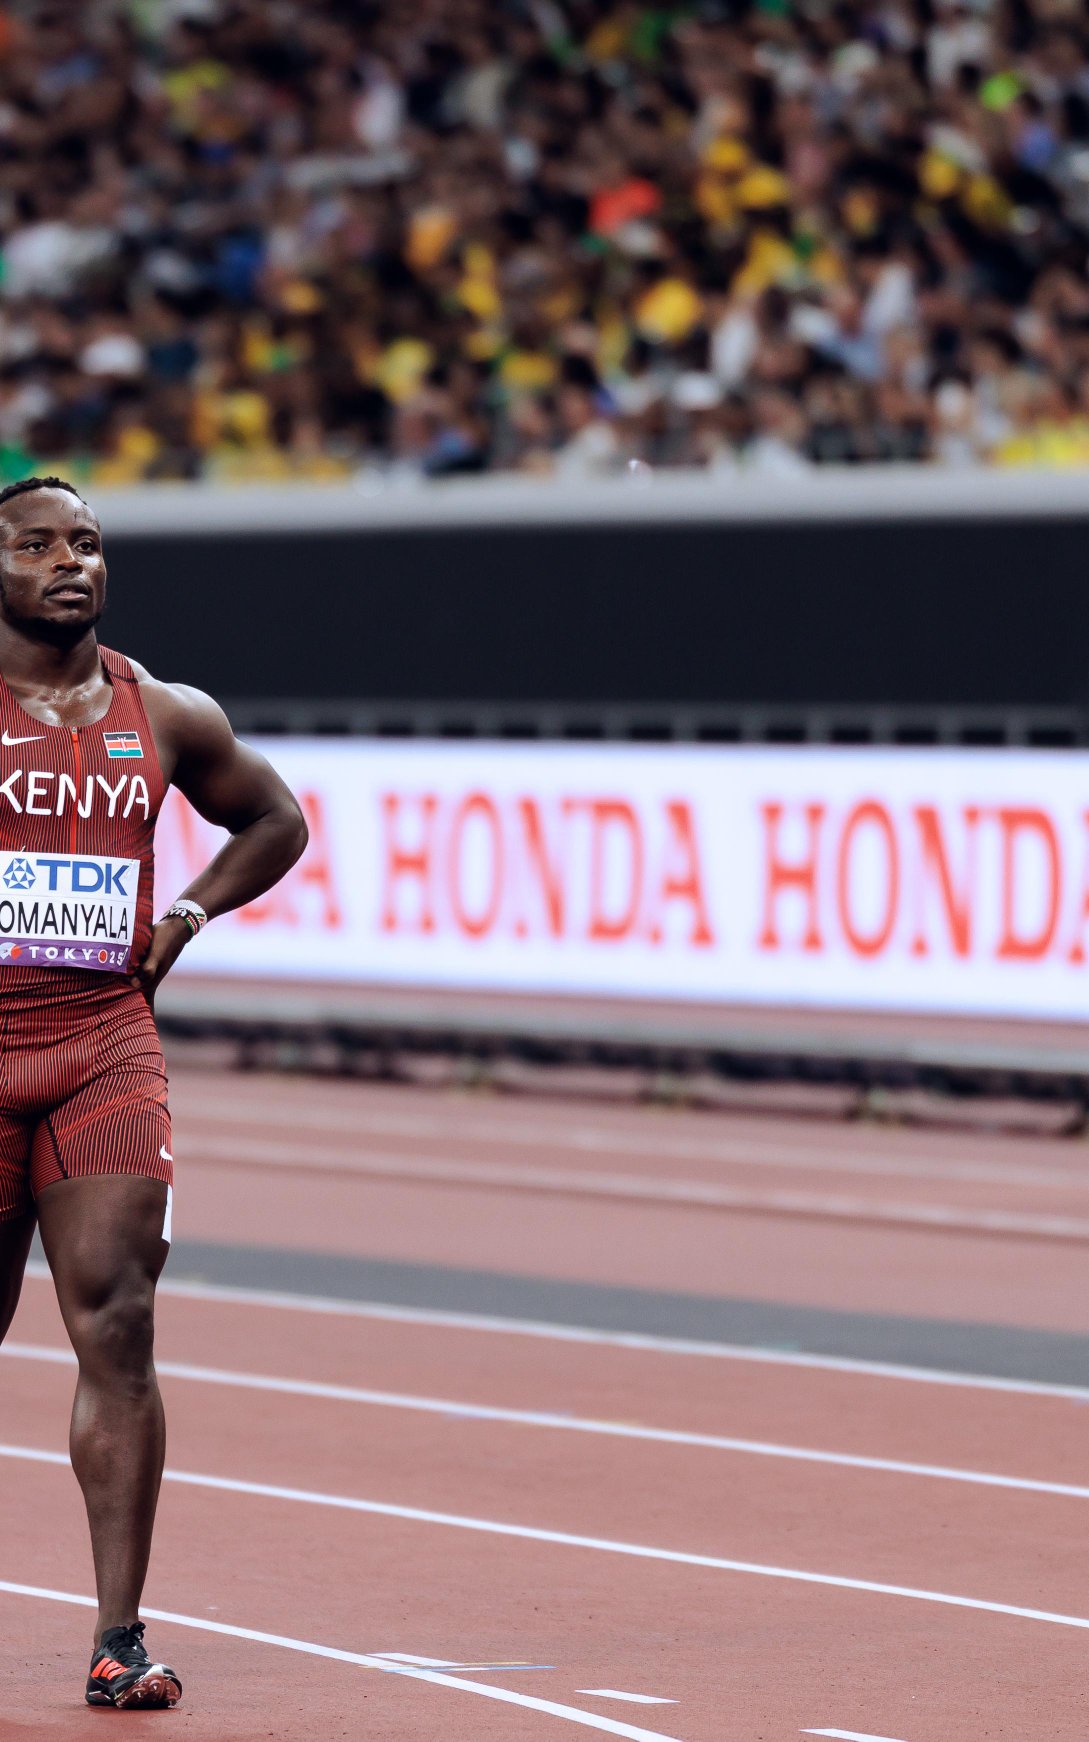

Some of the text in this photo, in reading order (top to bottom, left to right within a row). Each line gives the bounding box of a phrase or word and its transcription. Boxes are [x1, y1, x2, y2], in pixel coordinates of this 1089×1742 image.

[36, 859, 130, 896] TDK
[380, 790, 714, 949] HONDA
[756, 799, 1089, 966] HOND
